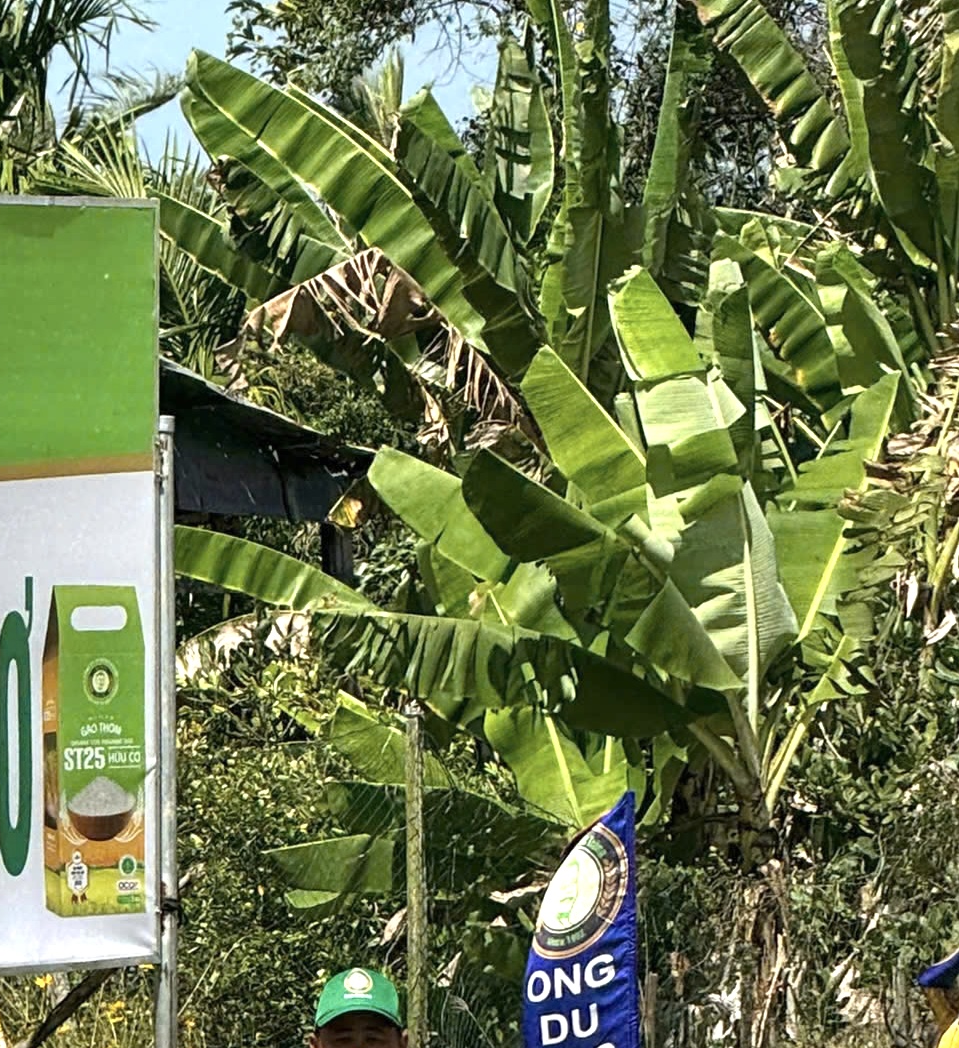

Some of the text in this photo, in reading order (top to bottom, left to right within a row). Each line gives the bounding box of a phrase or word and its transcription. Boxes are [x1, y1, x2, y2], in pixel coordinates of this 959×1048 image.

[63, 746, 106, 771] ST25
[527, 954, 616, 1003] ONG
[540, 1003, 599, 1046] DU
